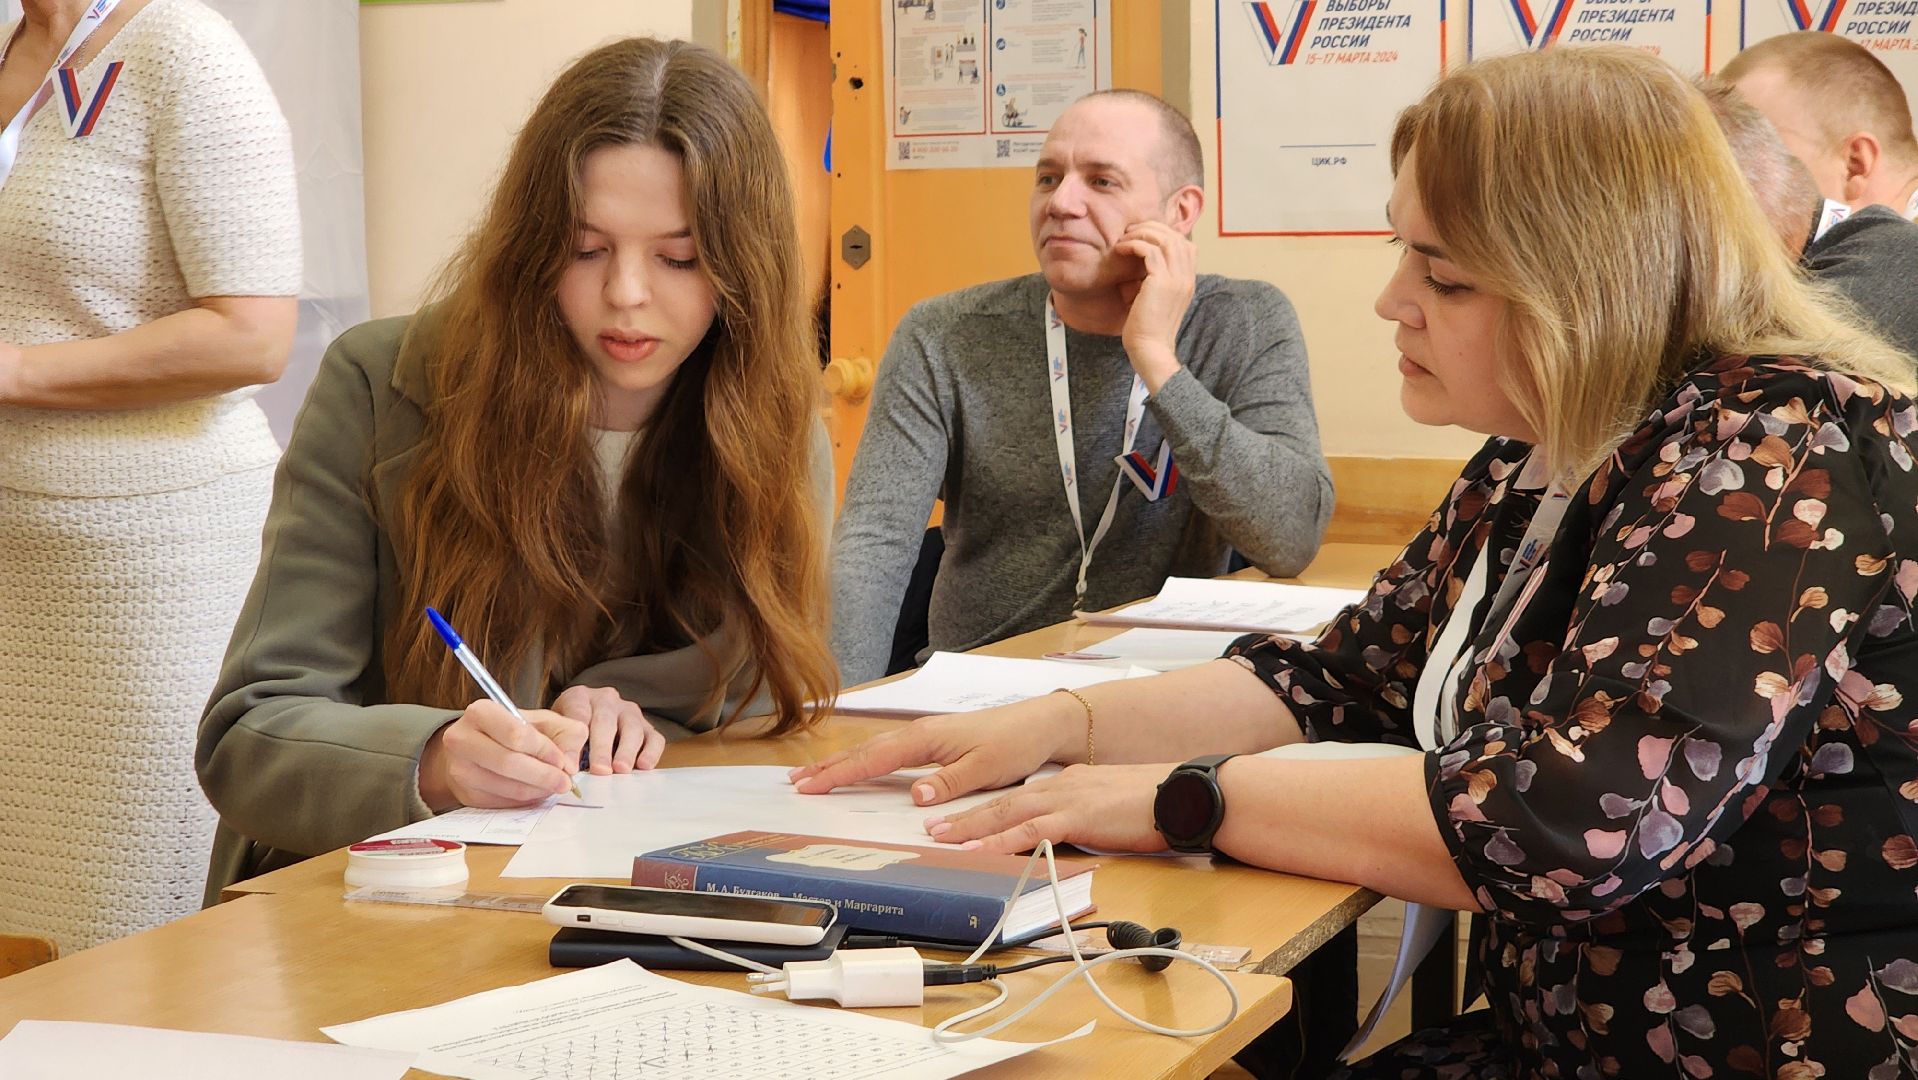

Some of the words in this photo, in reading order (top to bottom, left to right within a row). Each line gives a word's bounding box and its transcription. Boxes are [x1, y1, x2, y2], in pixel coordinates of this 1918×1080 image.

[1326, 0, 1391, 12] ВЫБОРЫ
[1854, 2, 1918, 16] ПРЕЗИД
[1318, 15, 1412, 31] ПРЕЗИДЕНТА
[1578, 8, 1675, 24] ПРЕЗИДЕНТА
[1568, 27, 1632, 42] РОССИИ
[1845, 21, 1911, 35] РОССИИ
[1310, 34, 1371, 49] РОССИИ
[1872, 37, 1912, 50] МАРТА
[1335, 51, 1372, 64] МАРТА
[1372, 50, 1399, 63] 2024
[1311, 157, 1347, 167] ЦИК.РФ
[706, 882, 719, 893] М.
[721, 884, 731, 894] А.
[834, 899, 843, 908] и
[843, 898, 905, 917] Маргарита
